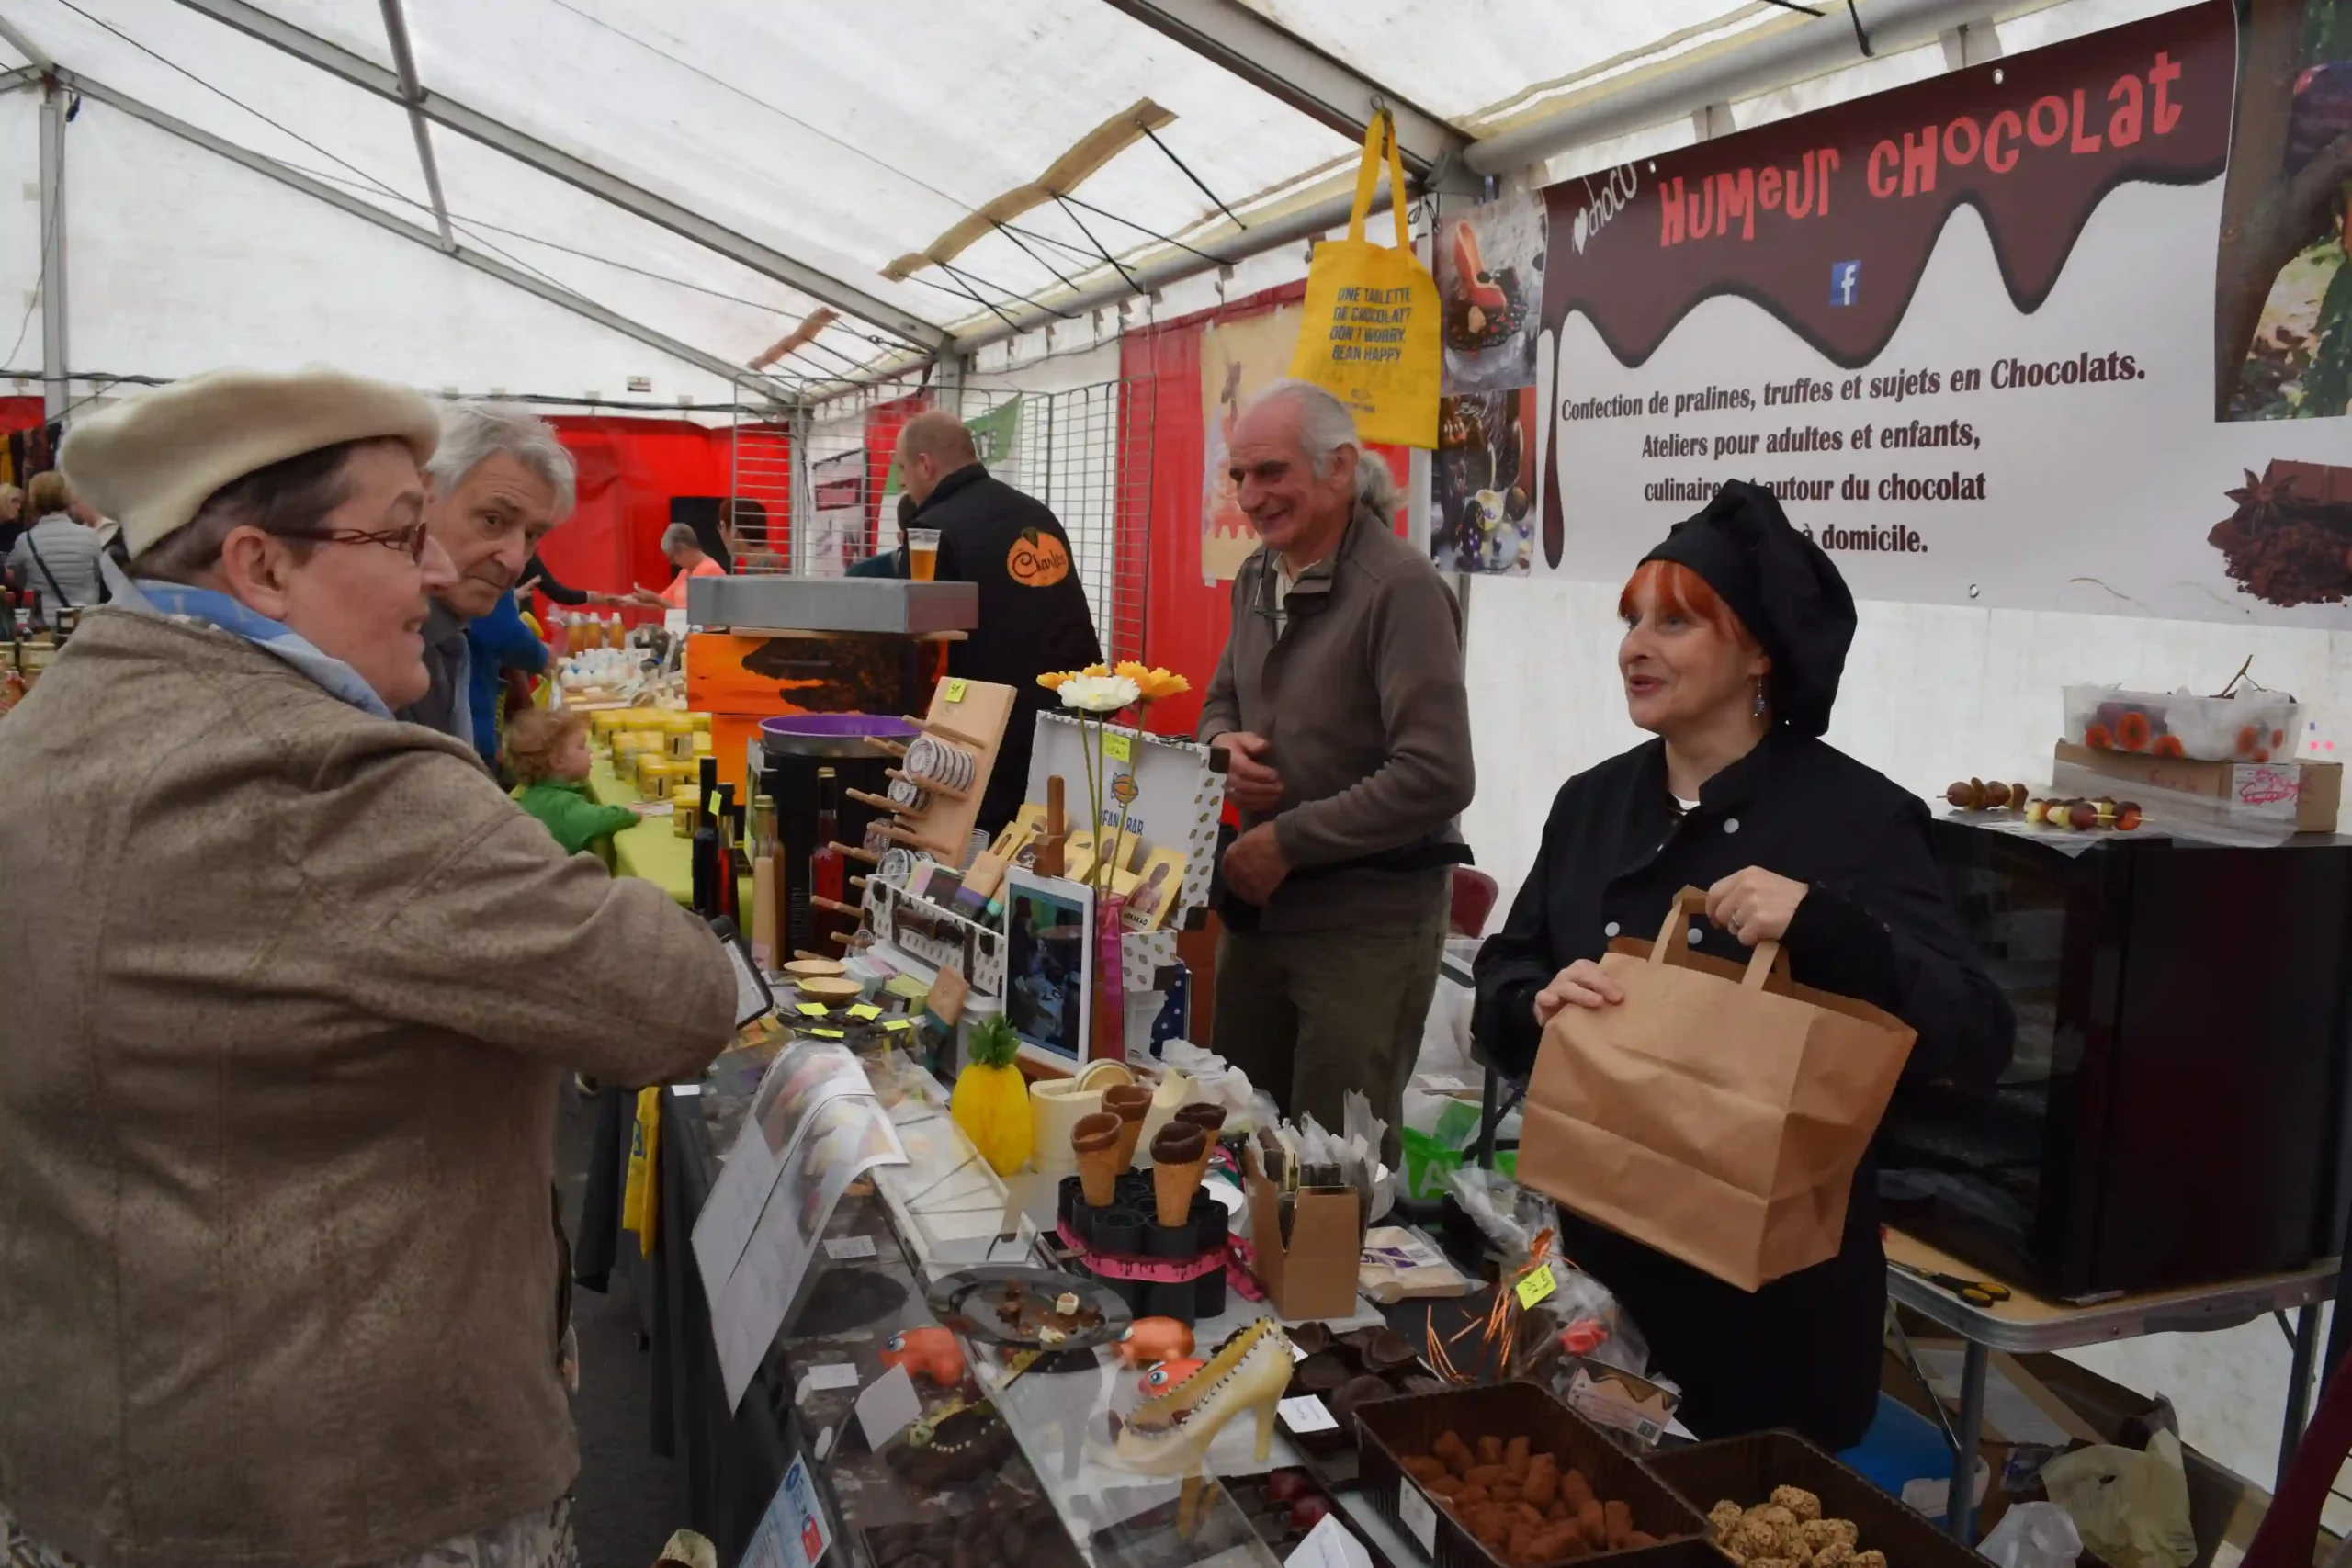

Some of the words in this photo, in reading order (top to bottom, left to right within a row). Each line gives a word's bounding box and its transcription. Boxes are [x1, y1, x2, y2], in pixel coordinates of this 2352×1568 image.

[1338, 287, 1361, 302] UNE
[1333, 307, 1349, 321] DE
[1332, 344, 1361, 361] BEAN
[1364, 346, 1402, 363] HAPPY
[1562, 394, 1643, 421] Confection
[1648, 391, 1668, 413] de
[1674, 386, 1756, 417] pralines,
[1764, 378, 1833, 406] truffes
[1840, 374, 1862, 400] et
[1869, 367, 1941, 402] sujets
[1950, 368, 1981, 392] en
[1990, 351, 2145, 389] Chocolats.
[1642, 433, 1708, 458] Ateliers
[1714, 434, 1760, 460] pour
[1766, 425, 1843, 454] adultes
[1850, 423, 1872, 449] et
[1880, 419, 1980, 450] enfants,
[1841, 474, 1870, 501] du
[1878, 471, 1986, 501] chocolat
[1822, 524, 1928, 552] domicile.
